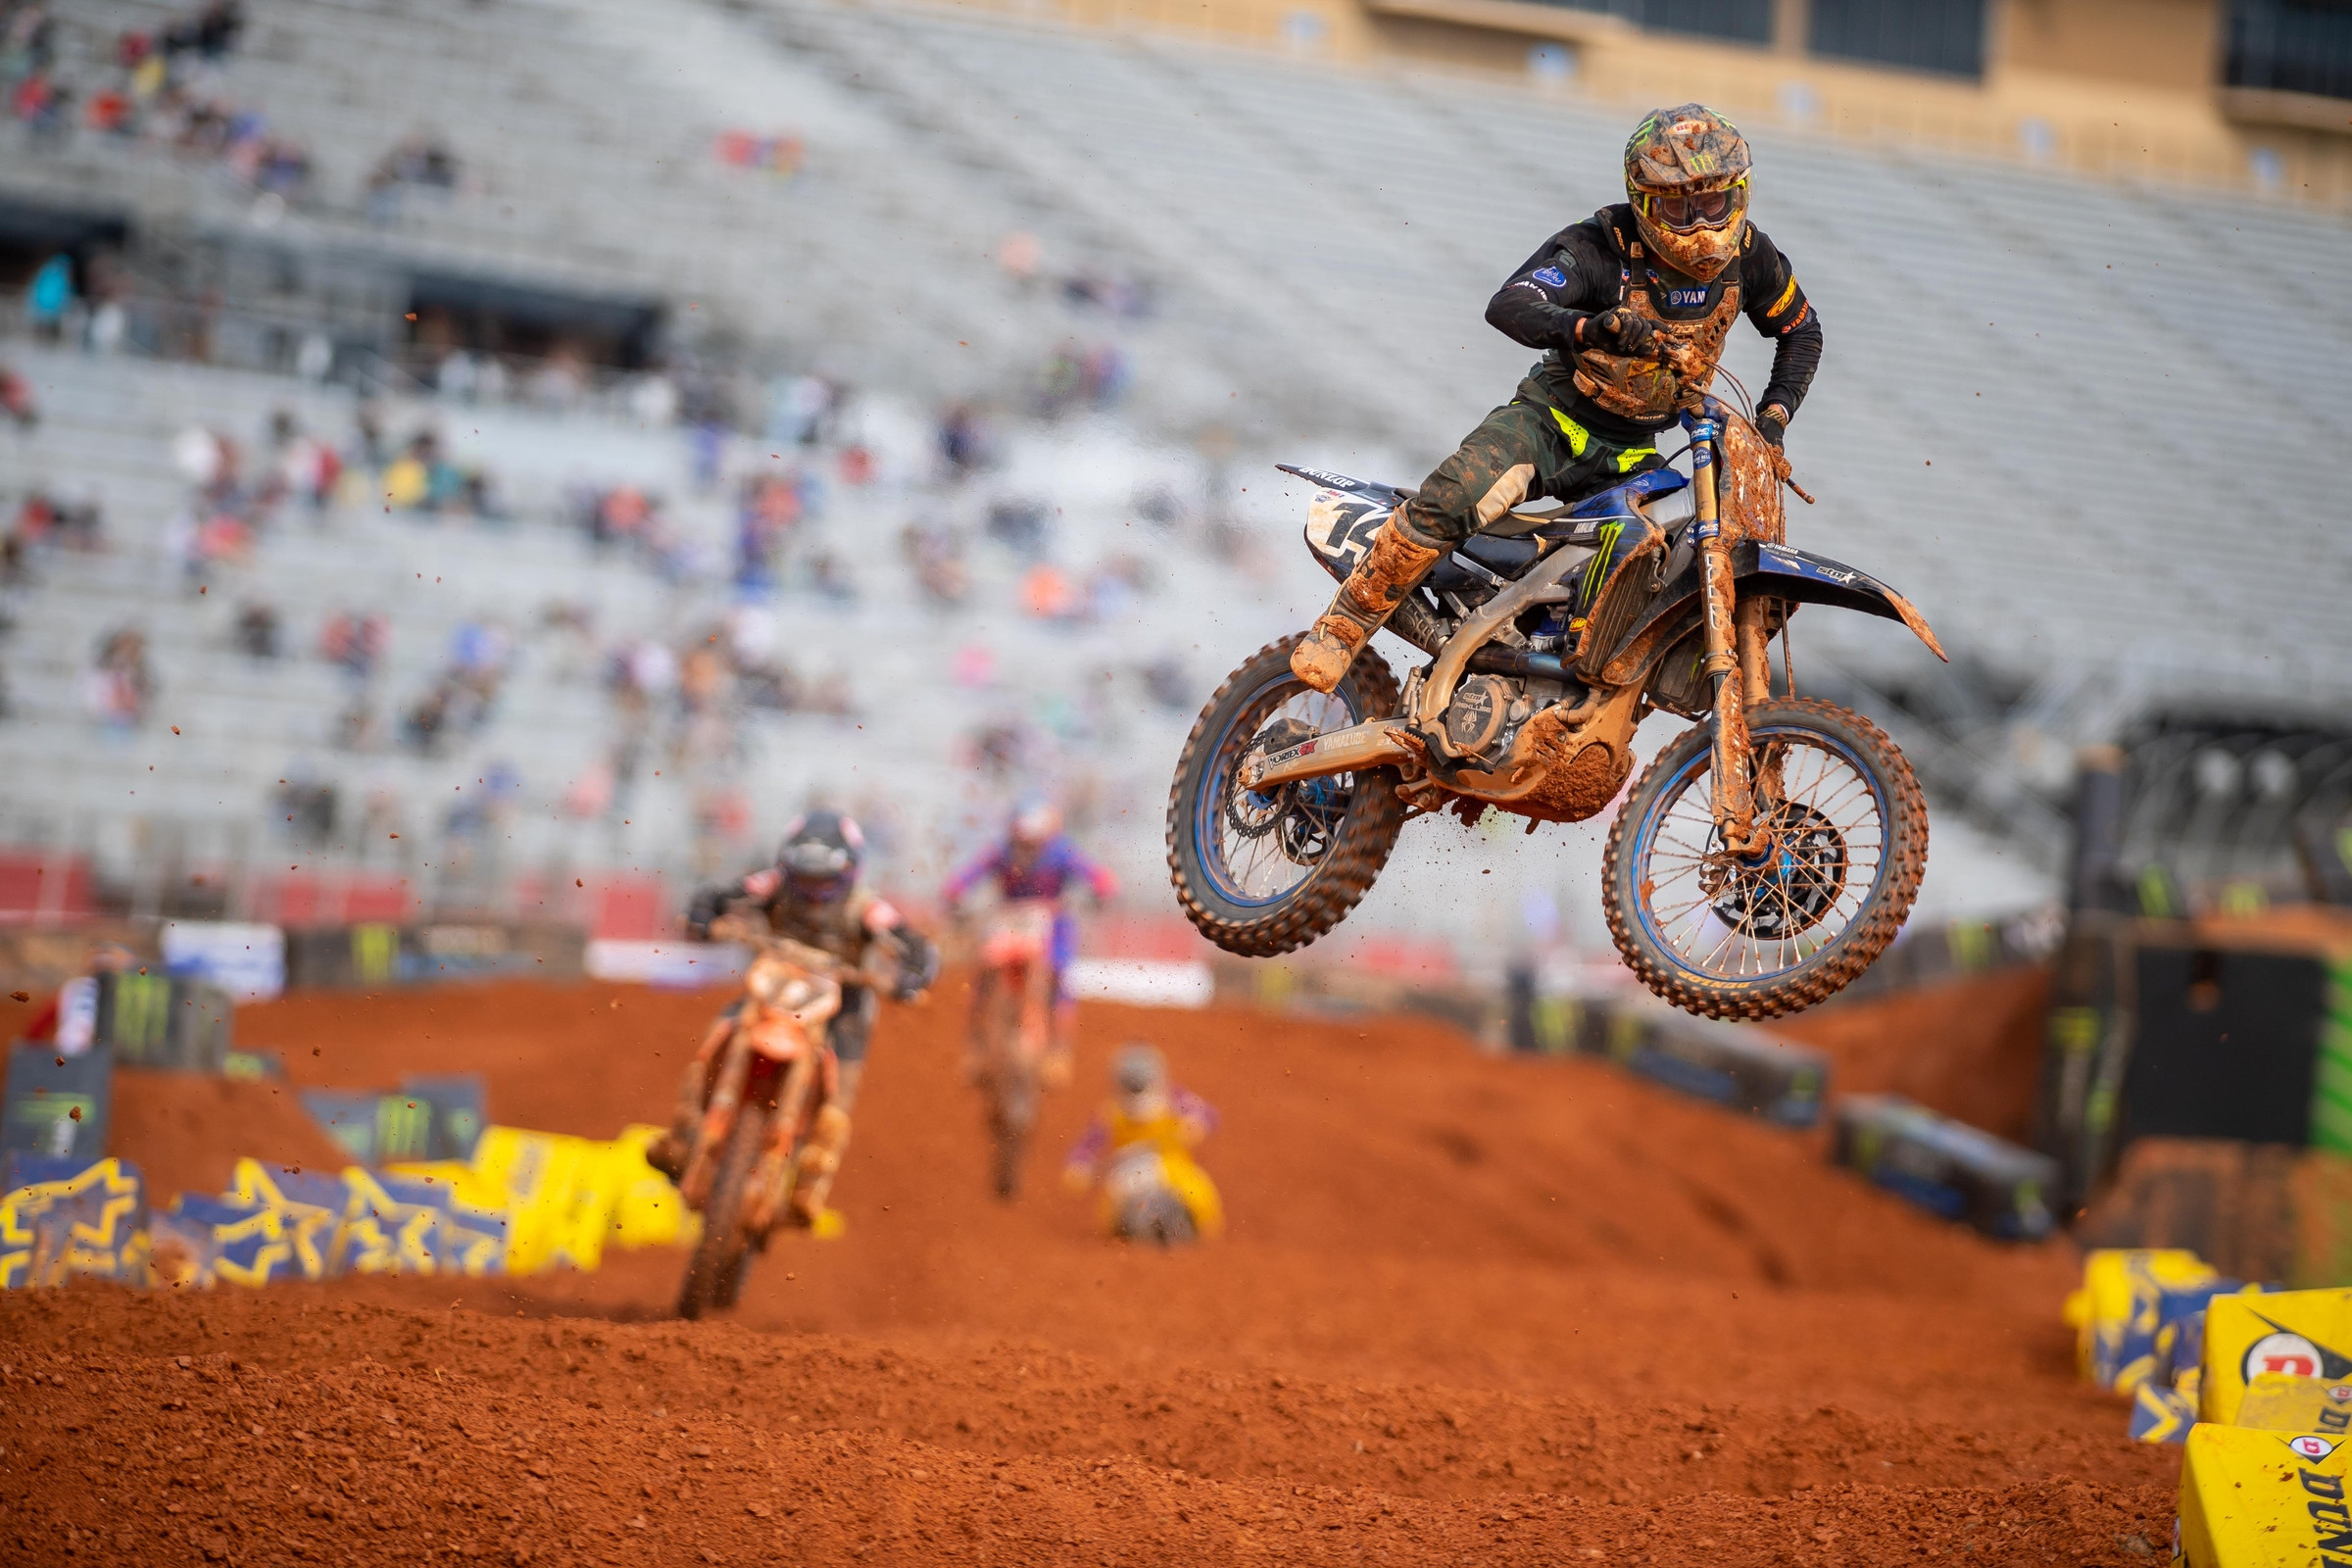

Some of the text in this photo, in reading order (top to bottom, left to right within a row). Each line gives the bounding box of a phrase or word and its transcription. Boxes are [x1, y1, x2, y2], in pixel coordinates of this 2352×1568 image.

[1298, 466, 1355, 488] DUNLOP
[1774, 544, 1799, 556] YAMAHA
[1455, 701, 1493, 713] REKLUSE
[1323, 731, 1366, 751] YAMALUBE
[1677, 971, 1751, 989] DUNLOP
